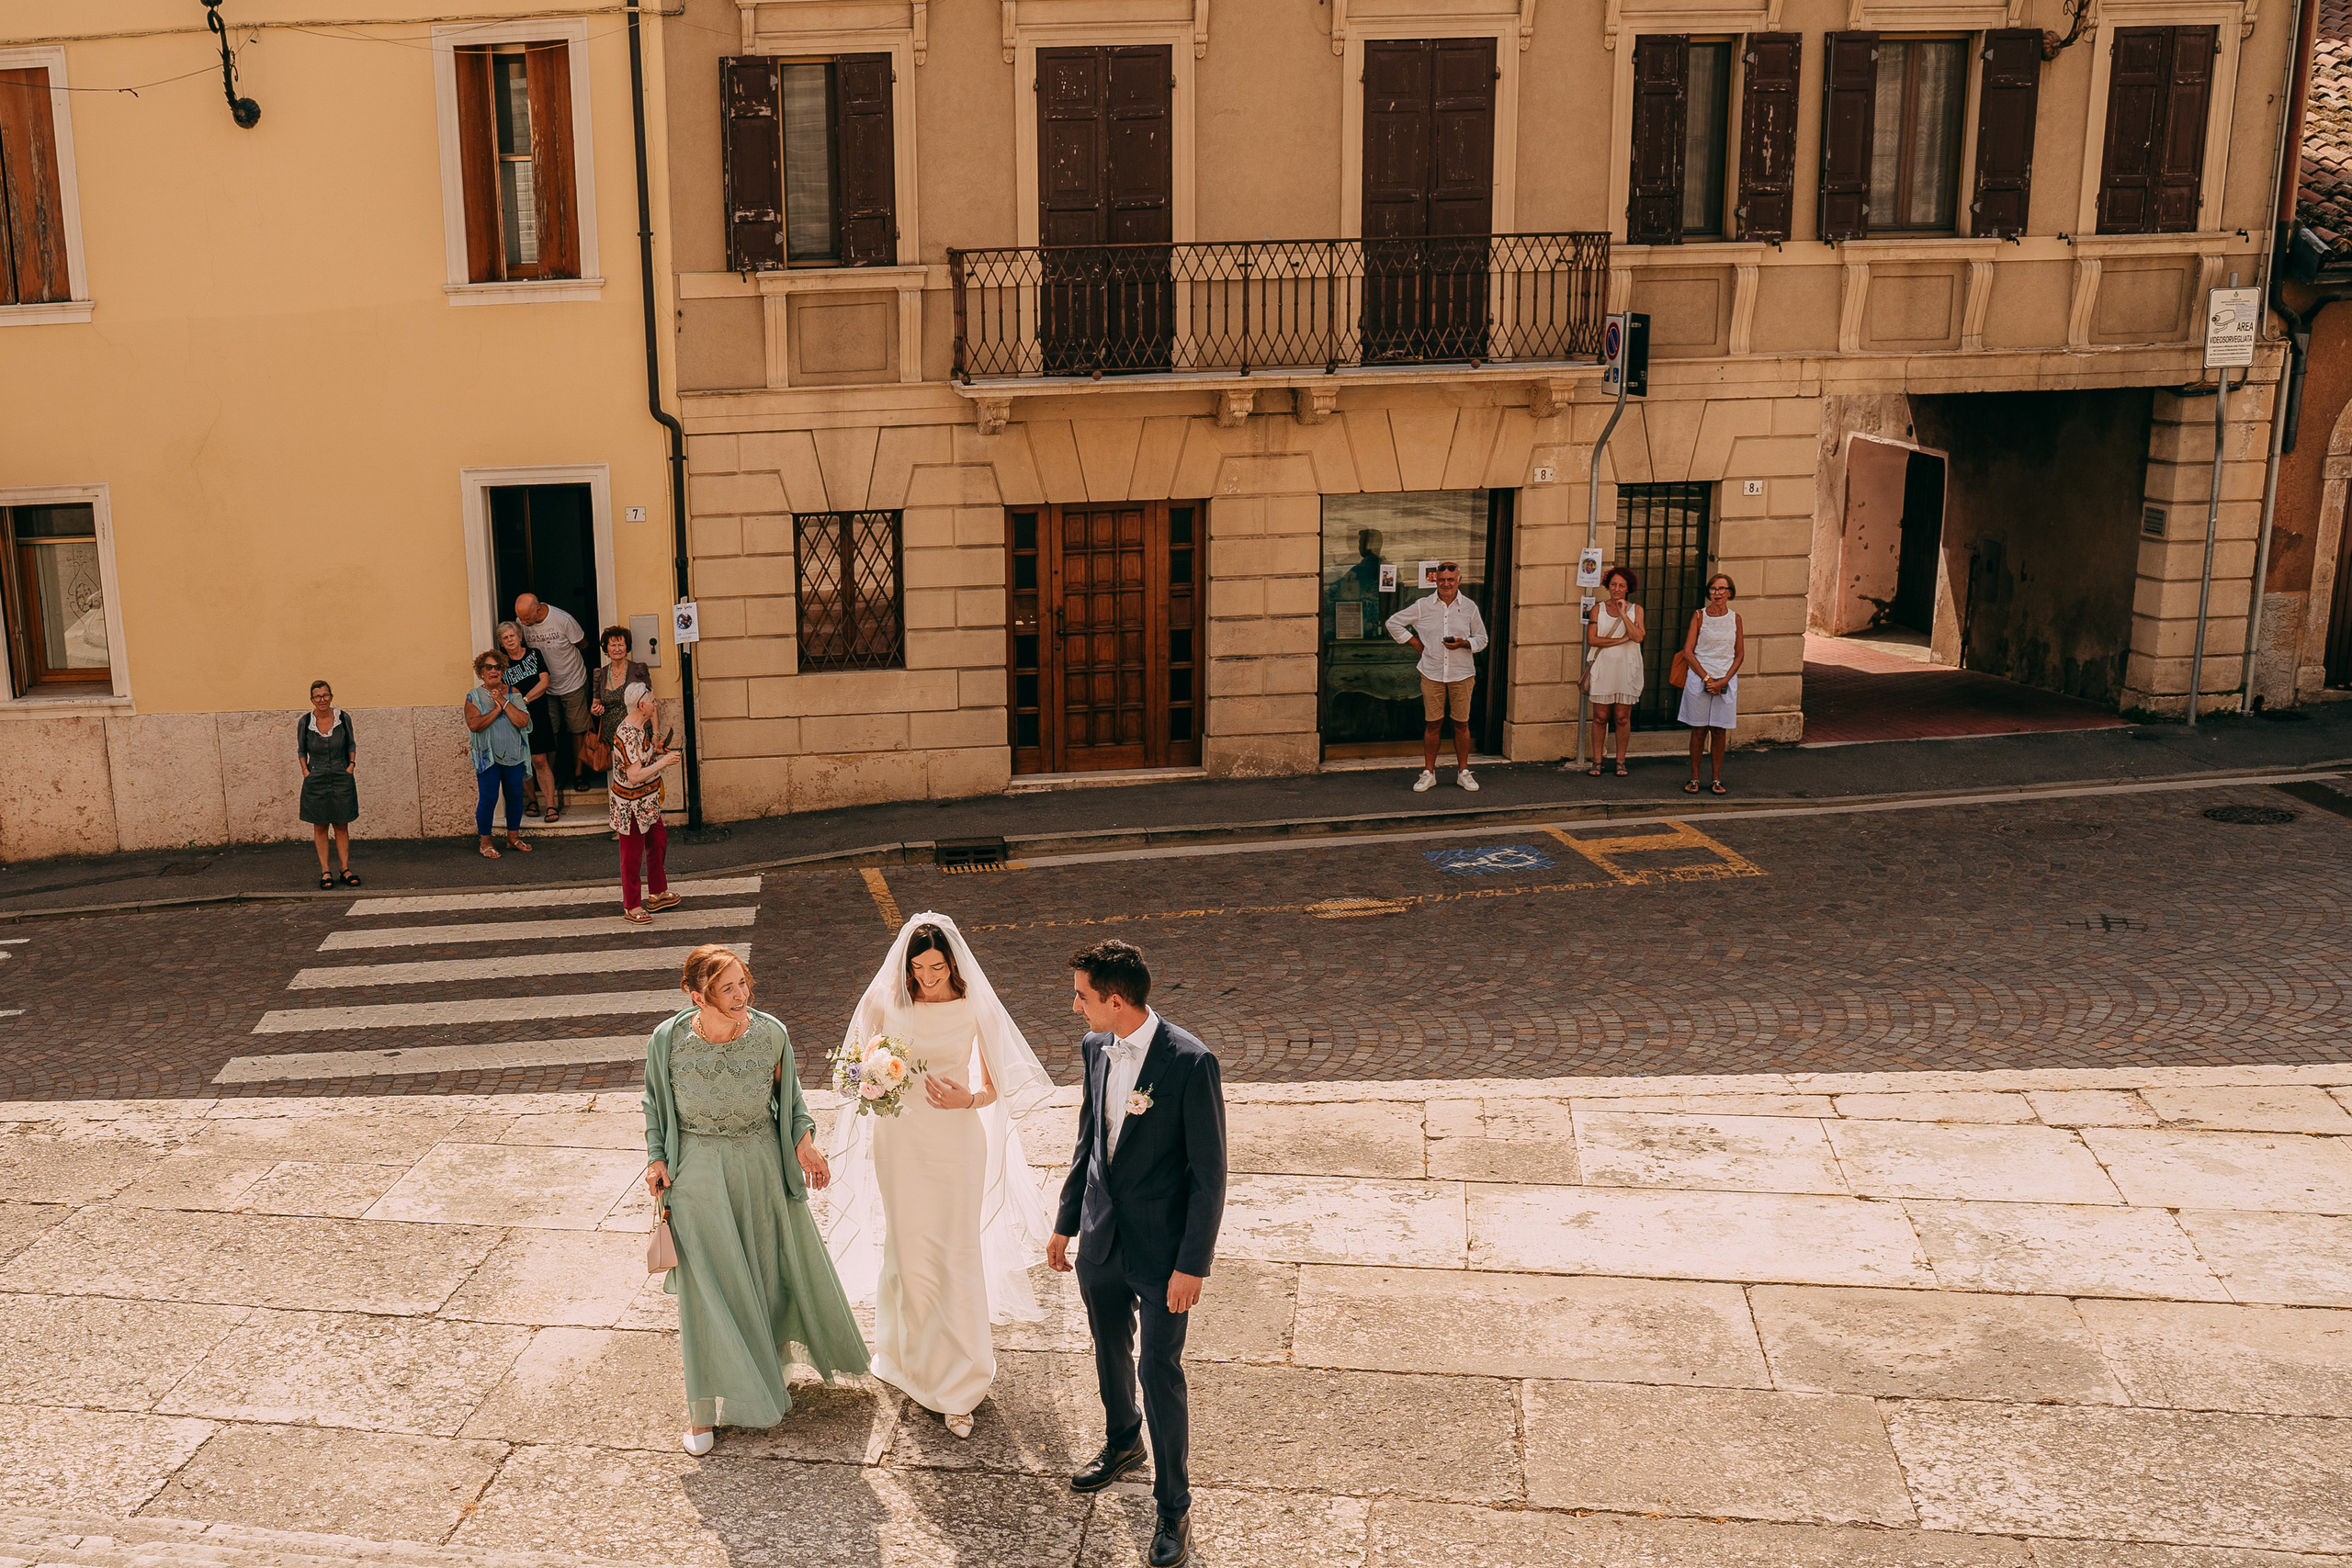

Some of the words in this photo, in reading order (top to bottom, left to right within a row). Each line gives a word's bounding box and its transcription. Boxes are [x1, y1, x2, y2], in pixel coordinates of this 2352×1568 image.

[2236, 321, 2254, 332] AREA
[2210, 334, 2253, 344] VIDEOSORVEGLIATA
[1541, 469, 1546, 480] 8
[633, 509, 639, 520] 7
